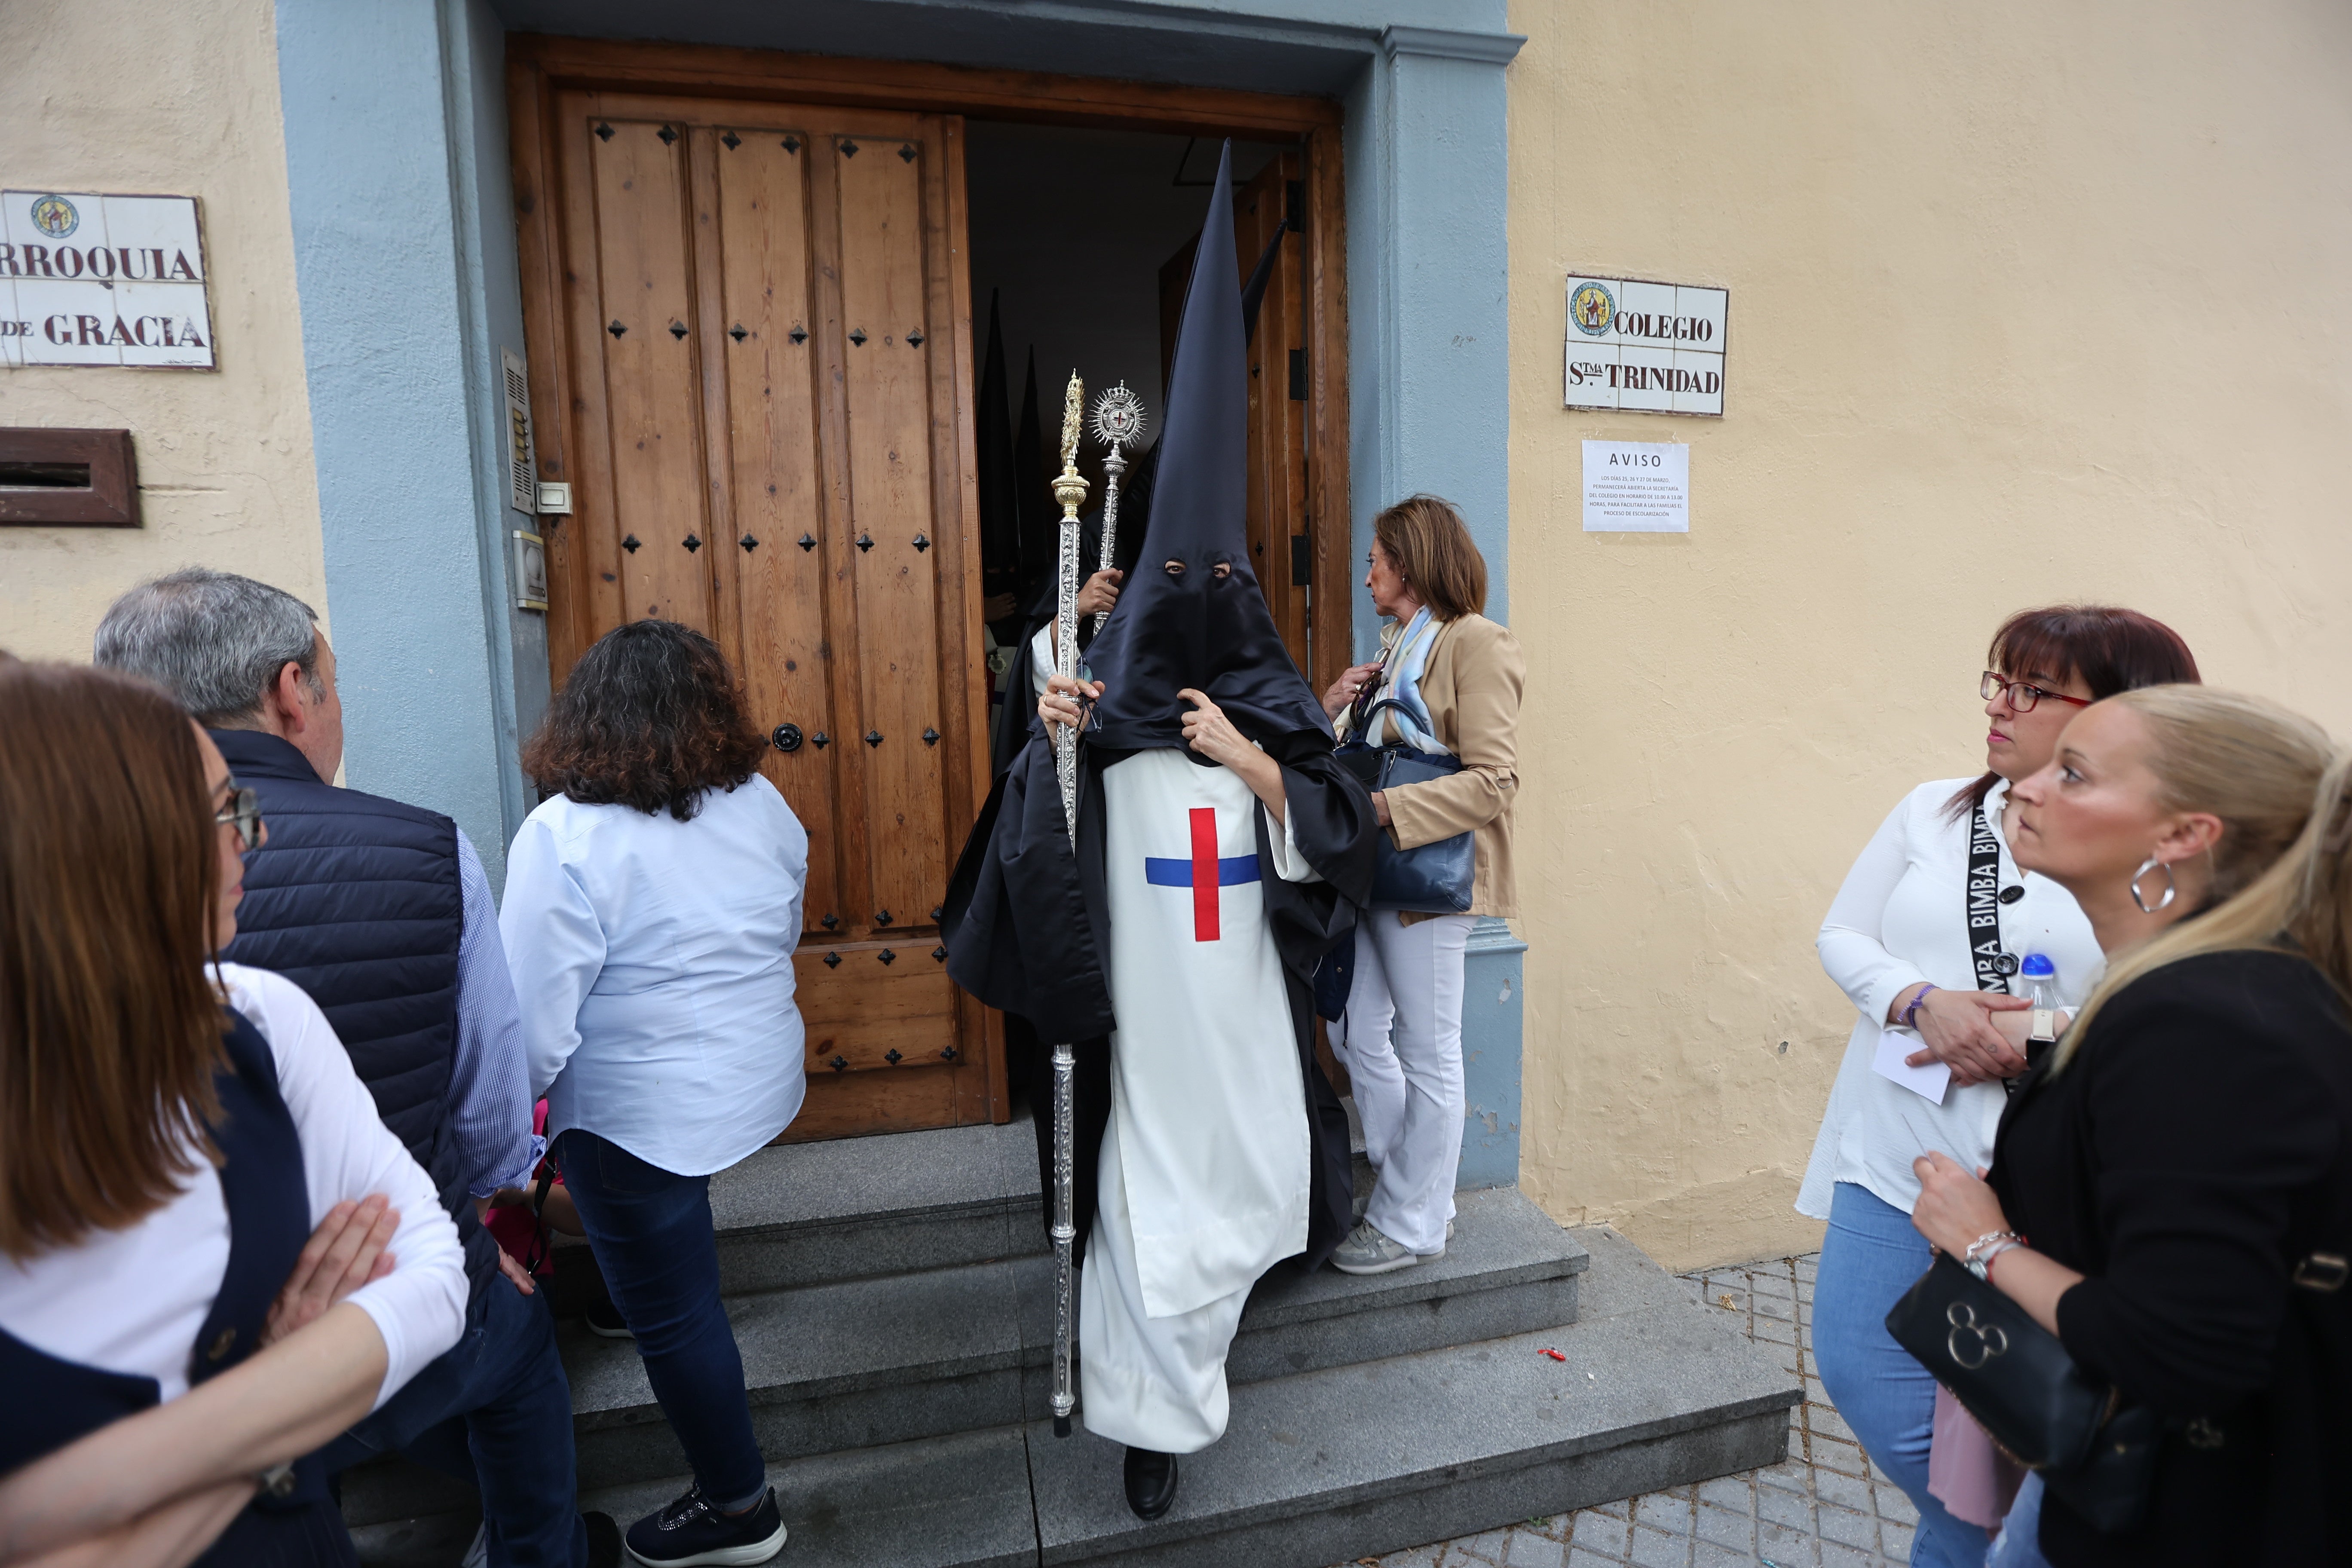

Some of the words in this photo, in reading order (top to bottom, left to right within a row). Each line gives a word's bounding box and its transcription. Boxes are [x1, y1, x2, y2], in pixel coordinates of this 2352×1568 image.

[0, 243, 200, 289] RROQUIA
[0, 321, 34, 336] DE
[44, 314, 208, 347] GRACIA
[1614, 310, 1712, 342] COLEGIO
[1605, 364, 1720, 394] TRINIDAD
[1609, 453, 1661, 467] AVISO
[1970, 863, 1997, 928] BIMBA
